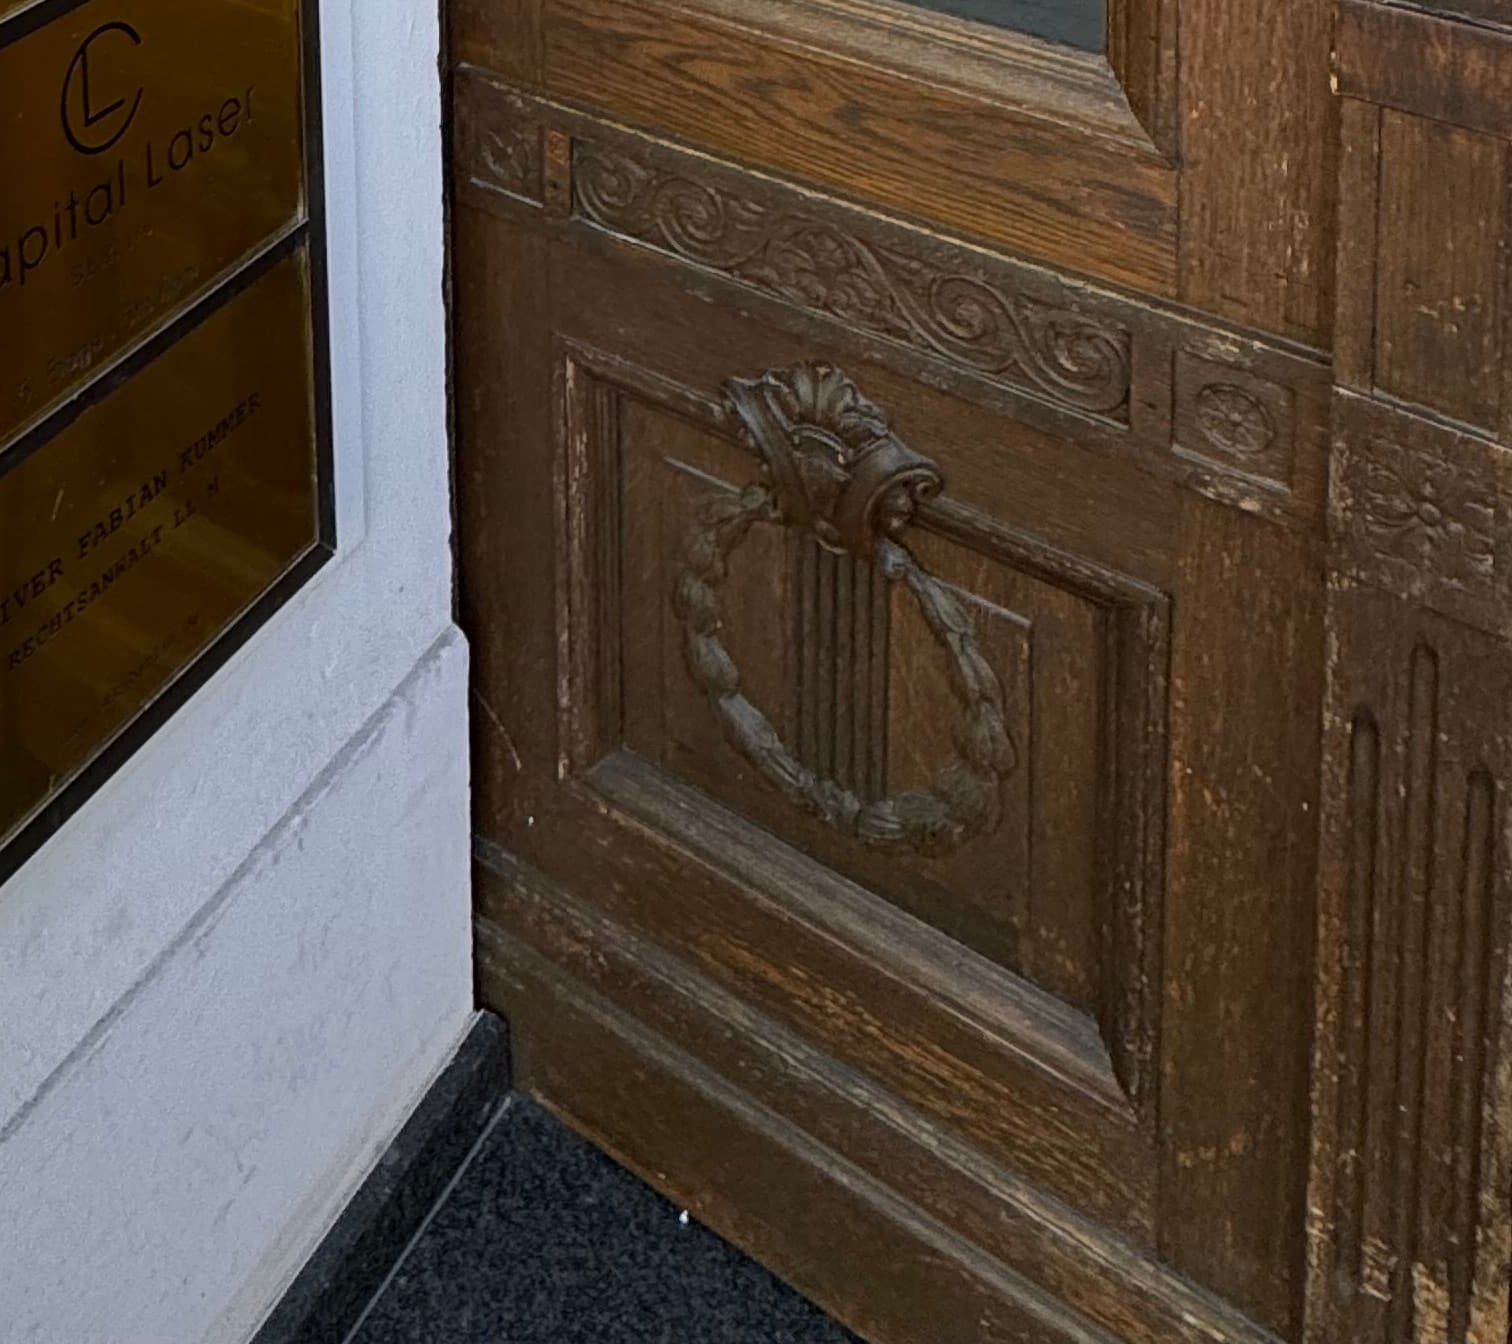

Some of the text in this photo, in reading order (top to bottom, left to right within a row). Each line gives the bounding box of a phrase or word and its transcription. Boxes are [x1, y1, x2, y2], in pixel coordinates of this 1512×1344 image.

[146, 85, 255, 189] Laser
[77, 468, 168, 560] FABIAN
[176, 391, 263, 474] KUMMER
[7, 524, 164, 672] RECHTSANWALT
